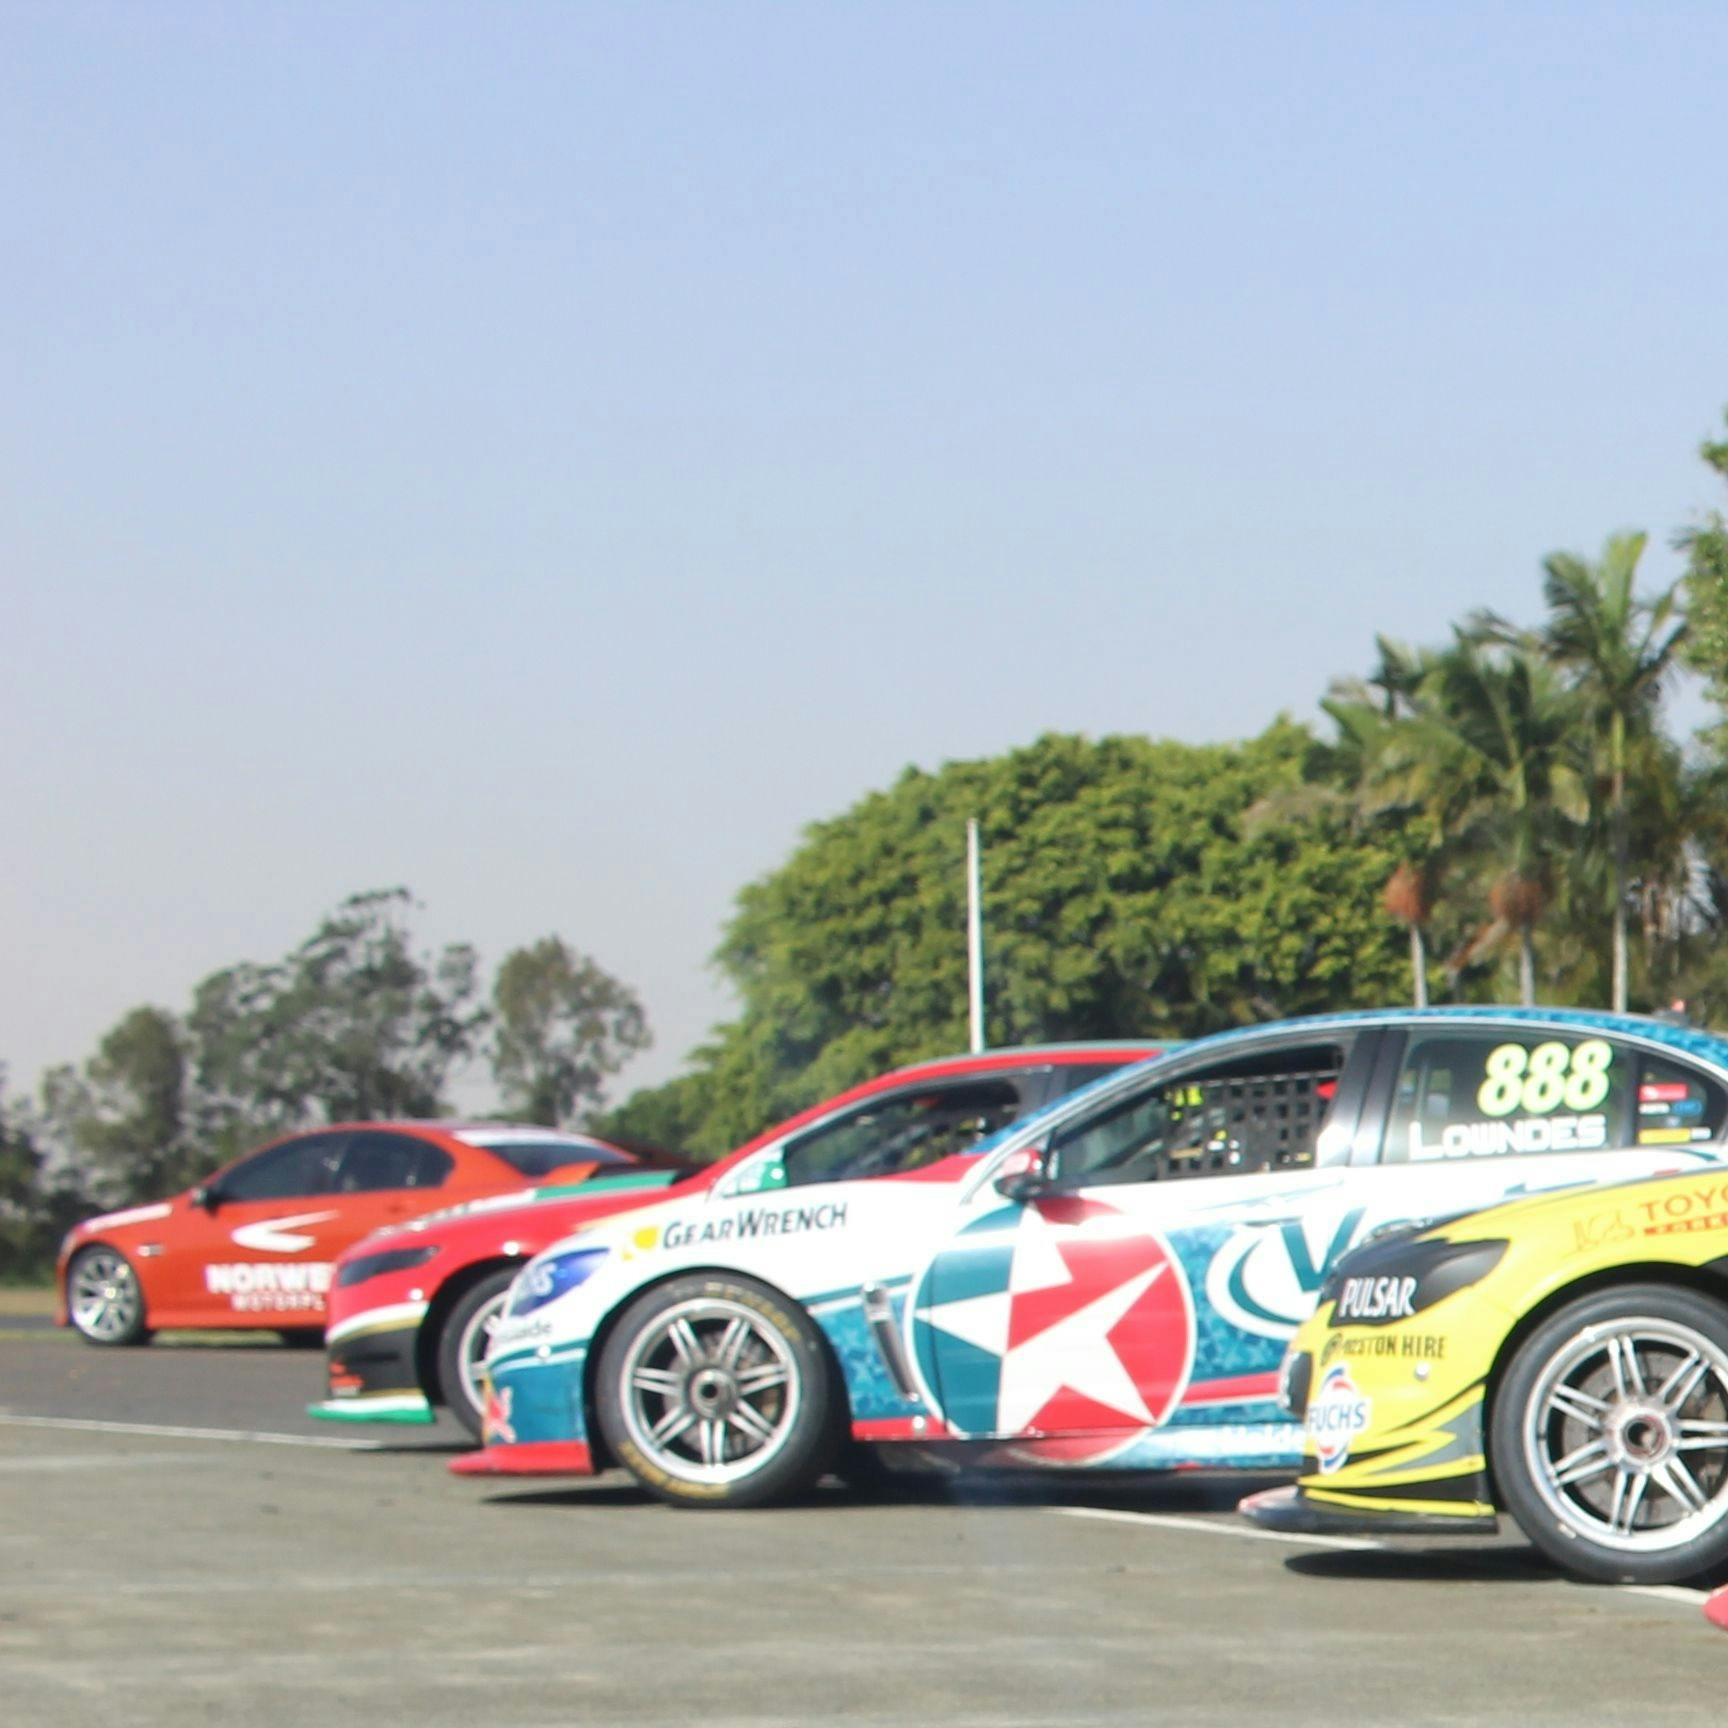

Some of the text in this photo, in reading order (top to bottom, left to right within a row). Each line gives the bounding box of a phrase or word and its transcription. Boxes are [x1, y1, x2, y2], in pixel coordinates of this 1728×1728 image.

[1477, 1040, 1613, 1116] 888
[1408, 1114, 1606, 1161] LOWNDES
[205, 1264, 336, 1294] NORWE
[1338, 1276, 1417, 1318] PULSAR
[1401, 1335, 1446, 1359] HIRE
[1308, 1402, 1366, 1432] FUCHS
